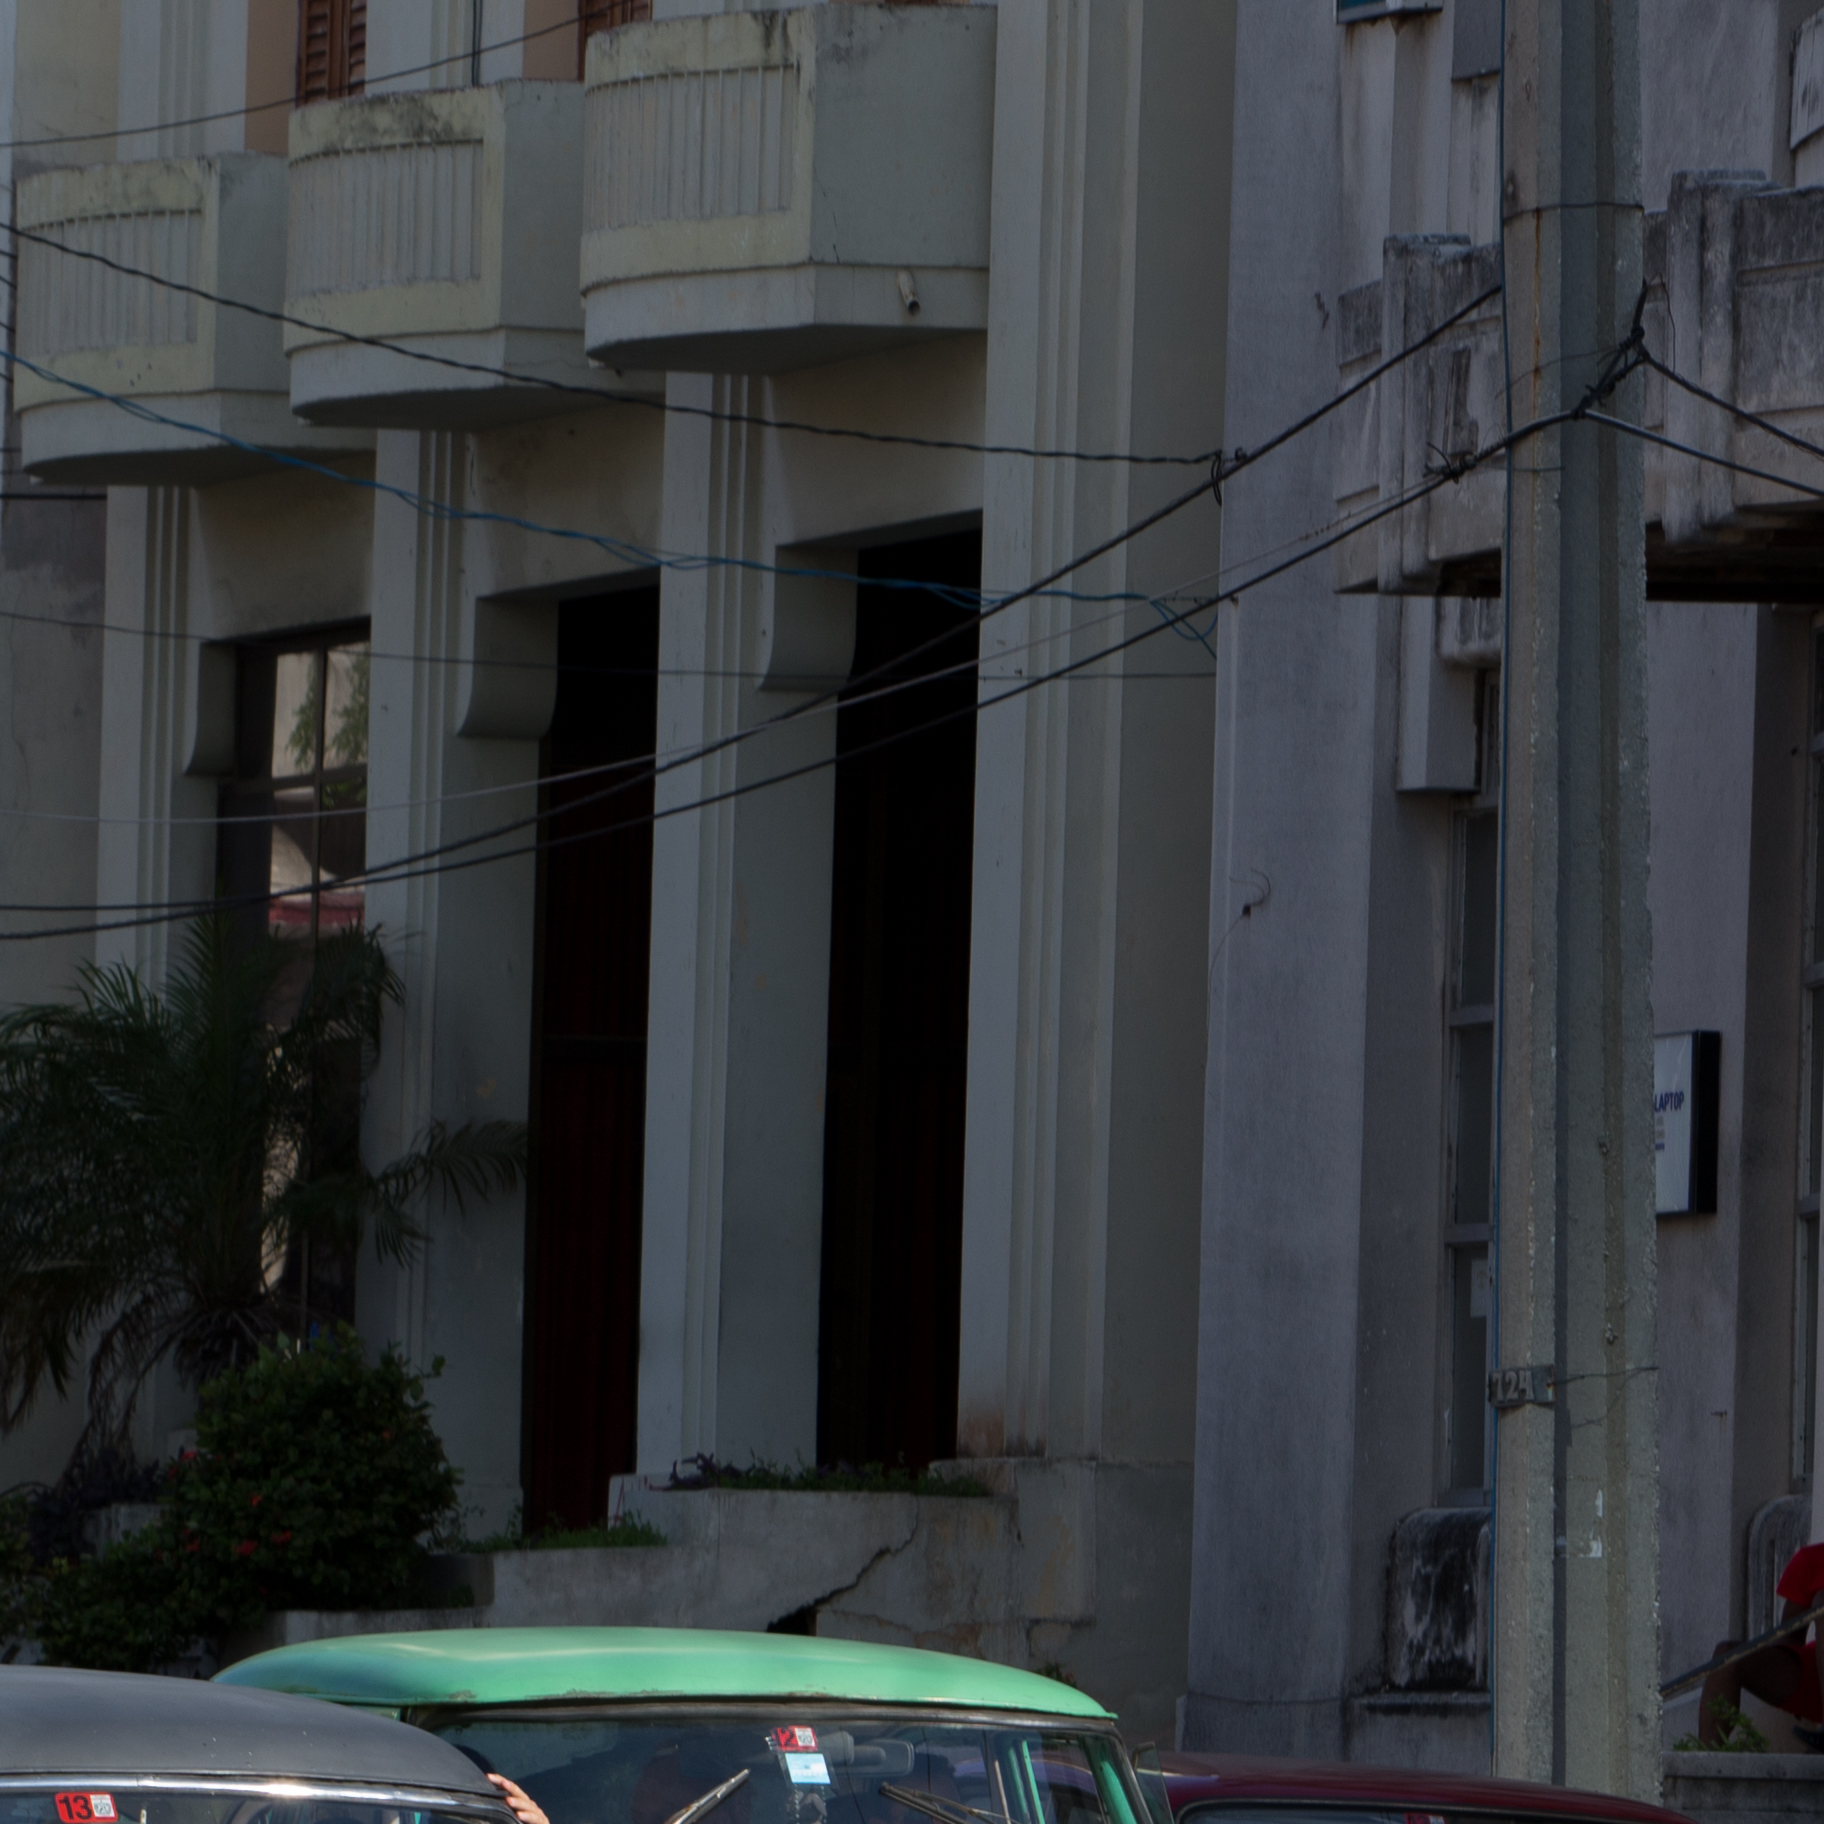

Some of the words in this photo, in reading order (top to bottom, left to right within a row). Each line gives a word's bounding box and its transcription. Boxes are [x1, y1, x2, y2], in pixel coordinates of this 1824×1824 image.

[1654, 1090, 1685, 1112] LAPTOP
[1492, 1370, 1535, 1401] 724
[58, 1795, 92, 1820] 13
